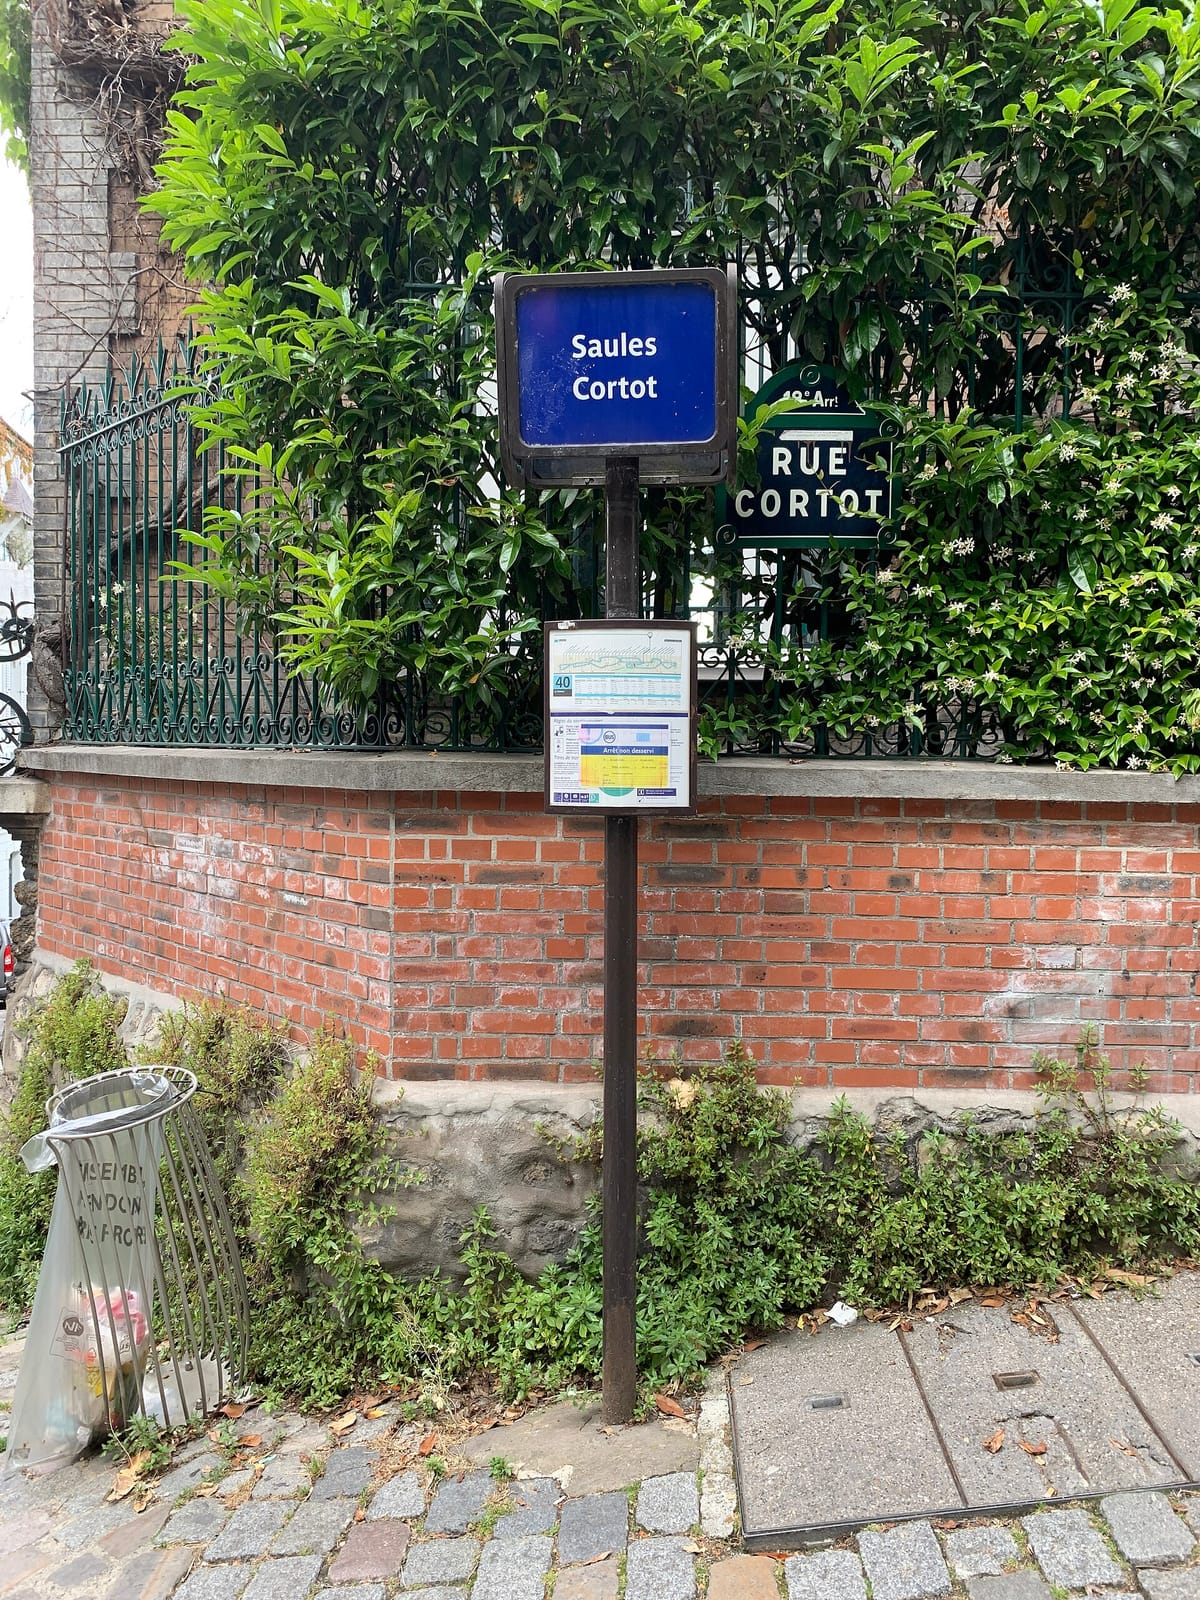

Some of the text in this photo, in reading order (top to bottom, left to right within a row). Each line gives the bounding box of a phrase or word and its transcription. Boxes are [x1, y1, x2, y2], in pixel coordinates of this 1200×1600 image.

[571, 332, 657, 359] Saules
[572, 376, 658, 400] Cortot
[772, 447, 847, 476] RUE
[735, 489, 883, 518] CORTOT
[555, 676, 571, 688] 40
